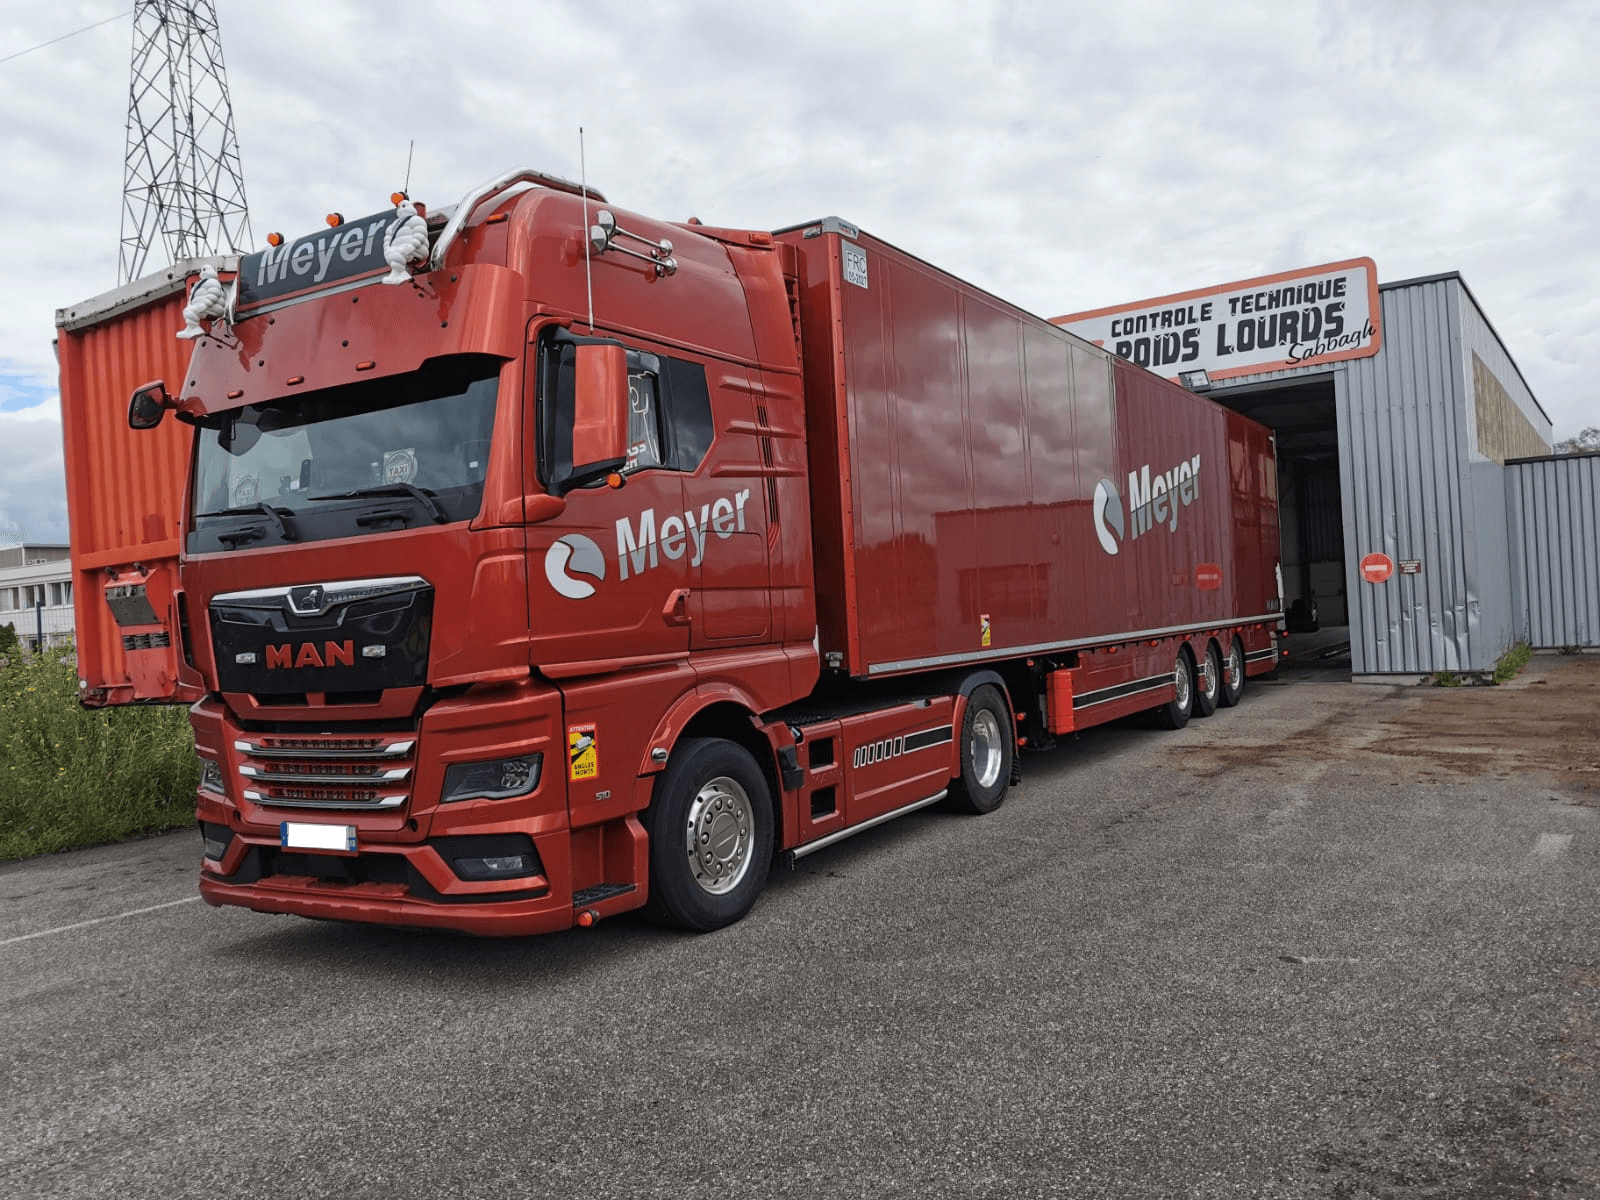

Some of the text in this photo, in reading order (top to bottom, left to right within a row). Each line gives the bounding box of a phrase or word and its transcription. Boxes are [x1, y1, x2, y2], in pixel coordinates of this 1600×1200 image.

[257, 217, 386, 287] Meyer
[847, 252, 866, 274] FRC
[1111, 277, 1347, 338] CONTROLE TECHNIQUE
[1116, 301, 1346, 368] POIDS LOURDS
[1284, 319, 1377, 365] Sabbagh
[388, 463, 409, 477] TAXI
[1128, 453, 1201, 541] Meyer
[615, 488, 750, 582] Meyer
[265, 639, 355, 670] MAN
